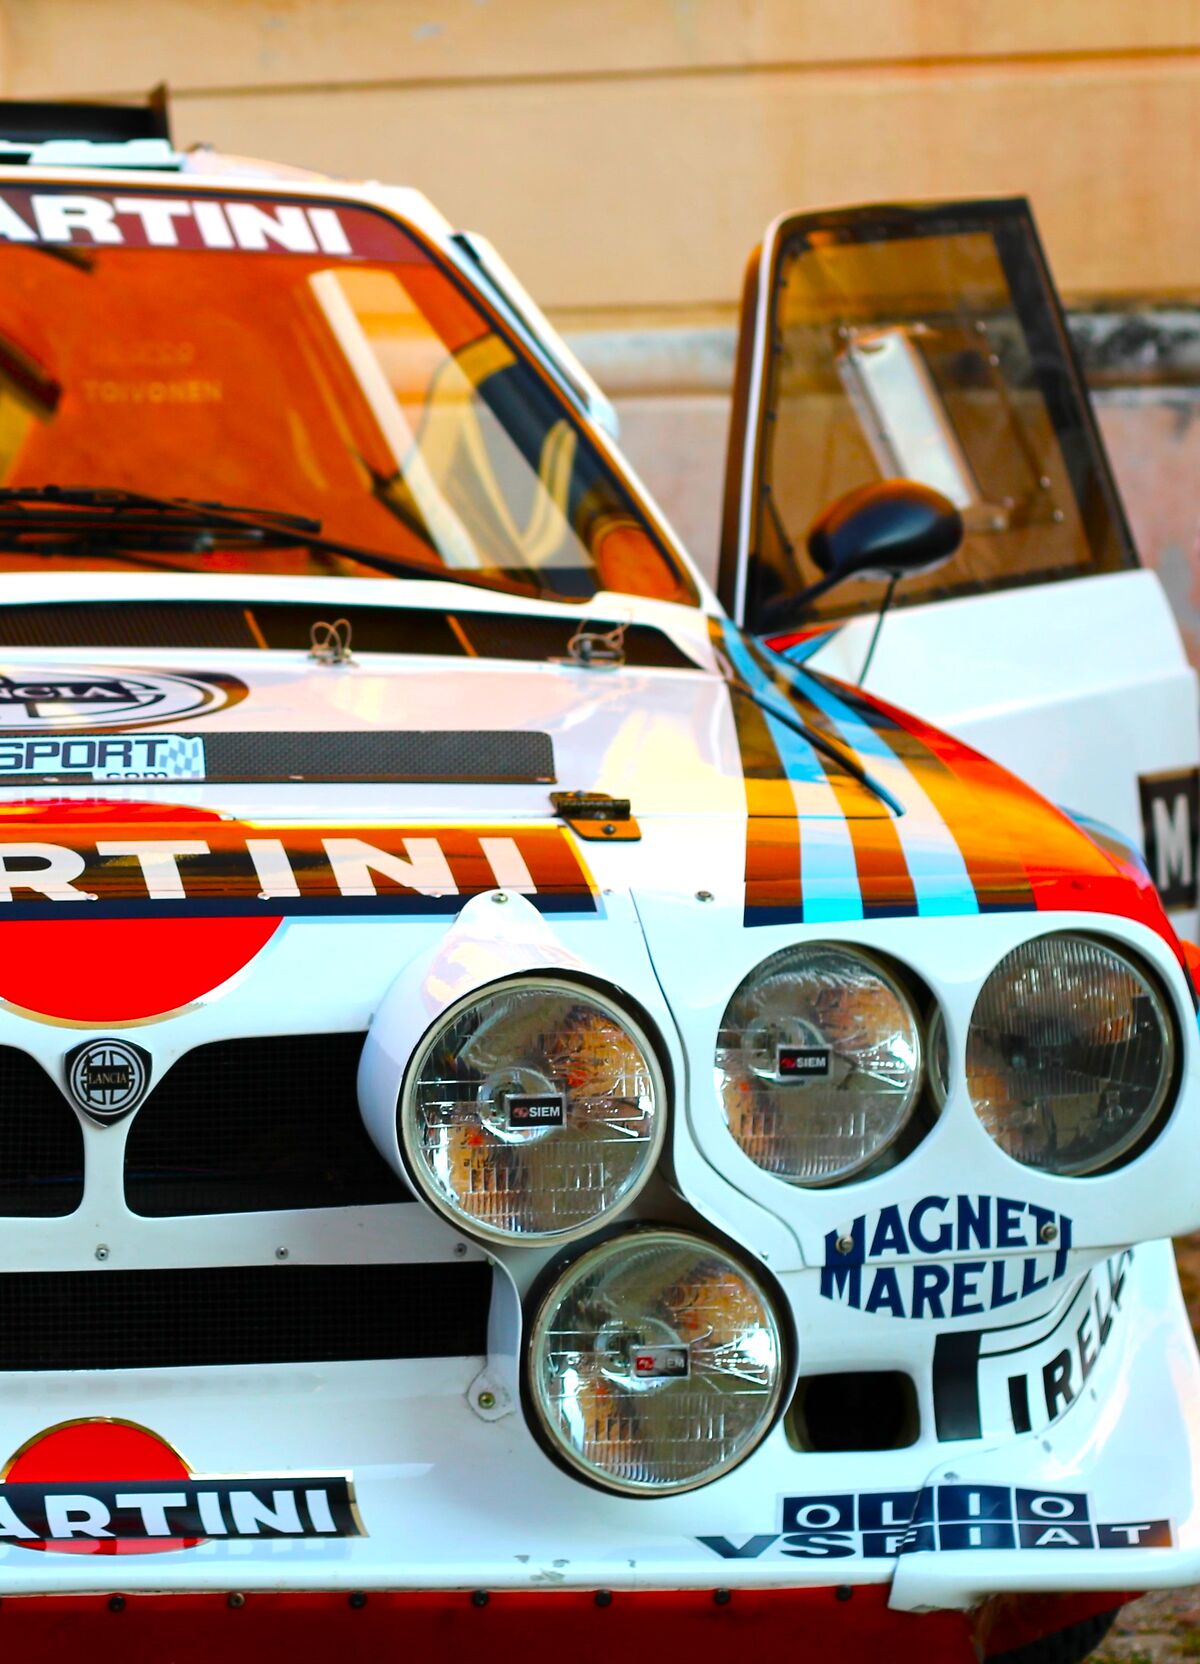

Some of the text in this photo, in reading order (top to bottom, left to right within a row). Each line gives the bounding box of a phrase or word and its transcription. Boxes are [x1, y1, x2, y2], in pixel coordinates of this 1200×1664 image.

[81, 379, 223, 403] TOIVONEN
[795, 1057, 827, 1068] SIEM
[87, 1072, 128, 1084] LANCIA
[528, 1106, 560, 1117] SIEM
[825, 1194, 1073, 1266] MAGNETI
[820, 1250, 1072, 1320] MARELLI
[795, 1492, 1075, 1529] OLIO
